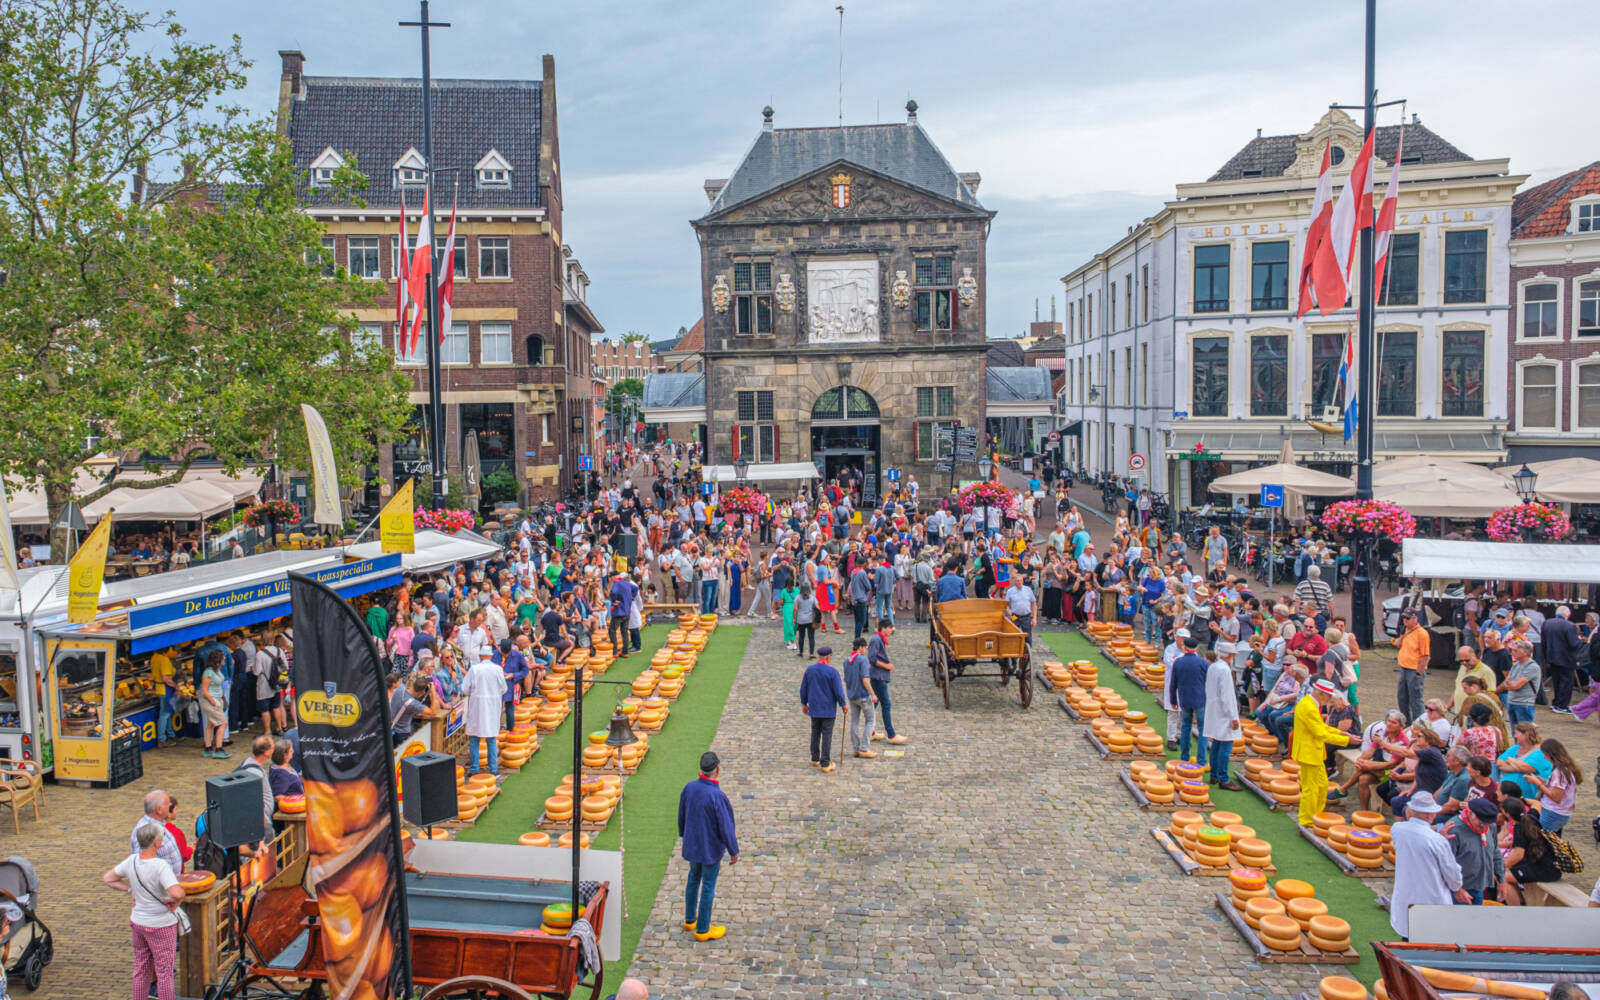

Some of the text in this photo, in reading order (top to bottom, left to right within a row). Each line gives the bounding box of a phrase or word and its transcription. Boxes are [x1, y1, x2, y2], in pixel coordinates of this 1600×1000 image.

[1205, 211, 1475, 238] HOTEL ZALM
[185, 562, 373, 614] De kaasboer uit Vli kaasspecialist
